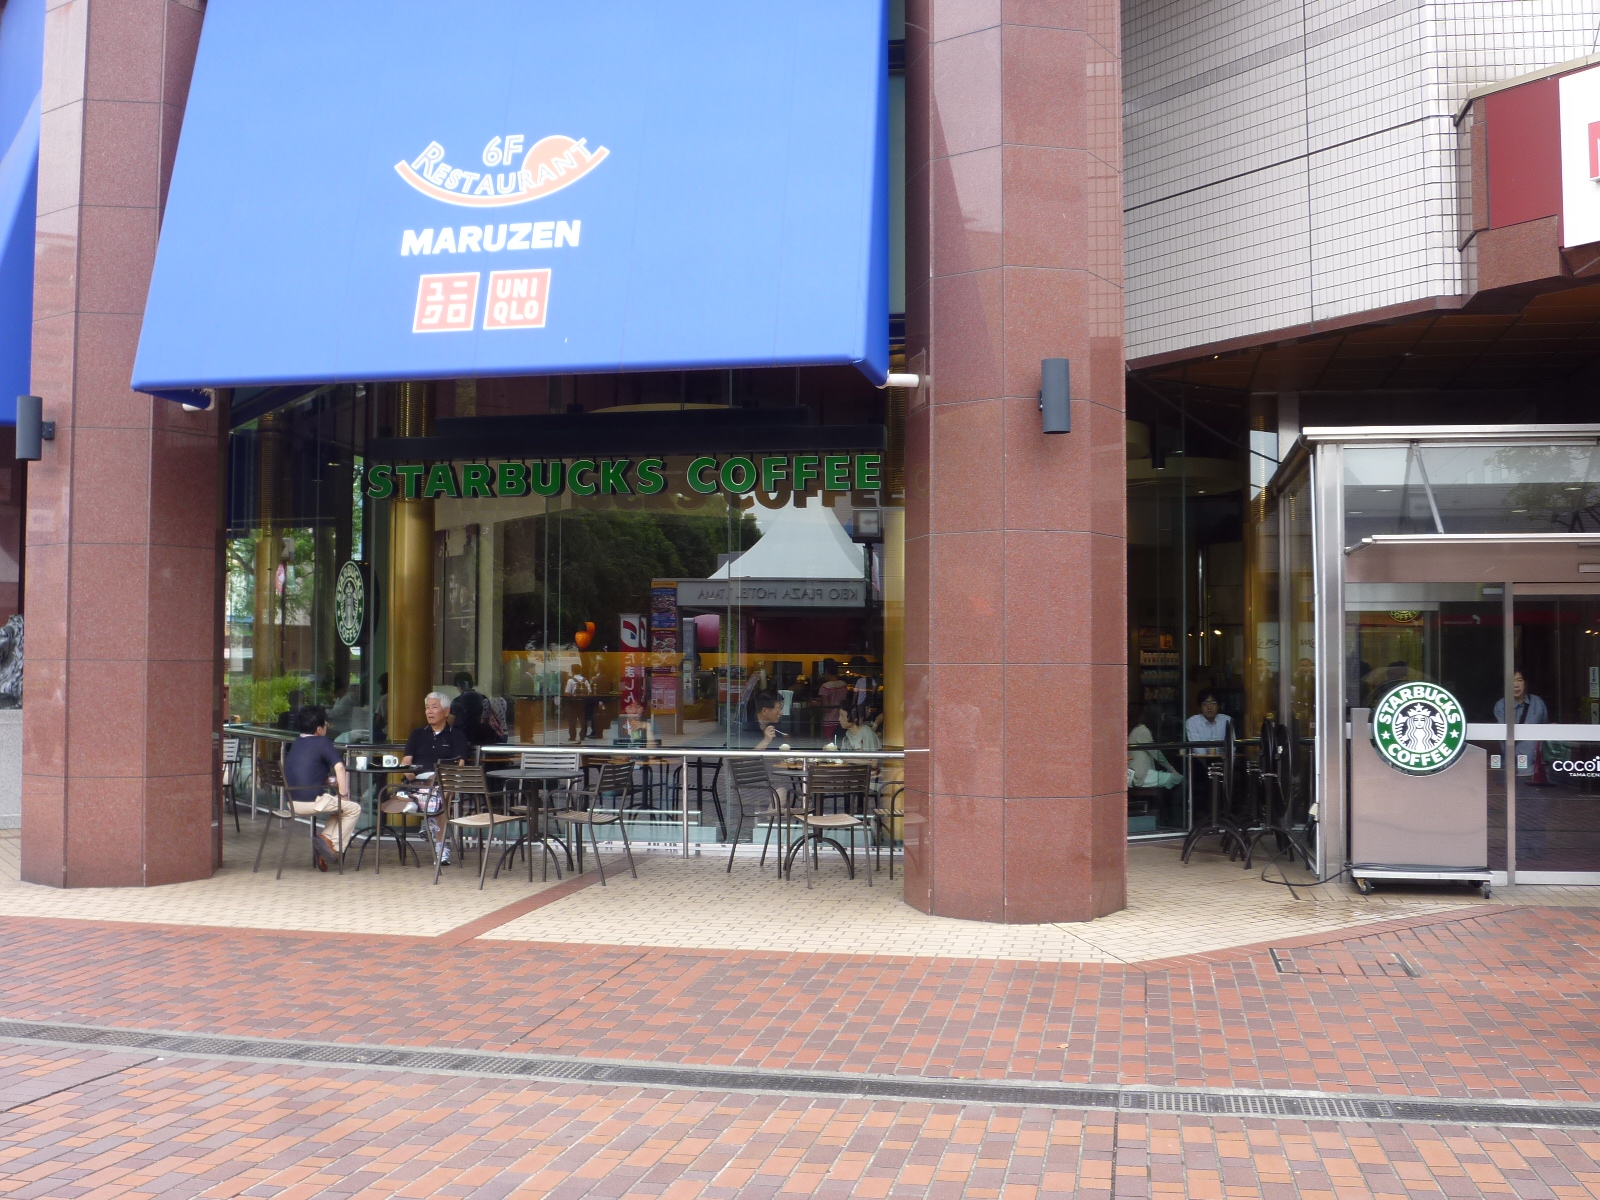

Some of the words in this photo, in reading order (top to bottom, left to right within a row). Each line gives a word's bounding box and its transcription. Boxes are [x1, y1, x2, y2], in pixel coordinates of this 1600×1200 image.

[482, 134, 525, 167] 6F
[410, 137, 593, 196] RESTAURANT
[400, 219, 582, 257] MARUZEN
[426, 280, 468, 302] ユニ
[495, 277, 538, 299] UNI
[421, 303, 467, 325] クロ
[493, 299, 539, 325] QLO
[367, 458, 665, 499] STARBUCKS
[686, 454, 882, 494] COFFEE
[1379, 686, 1461, 725] STARBUCKS
[1388, 742, 1453, 766] COFFEE
